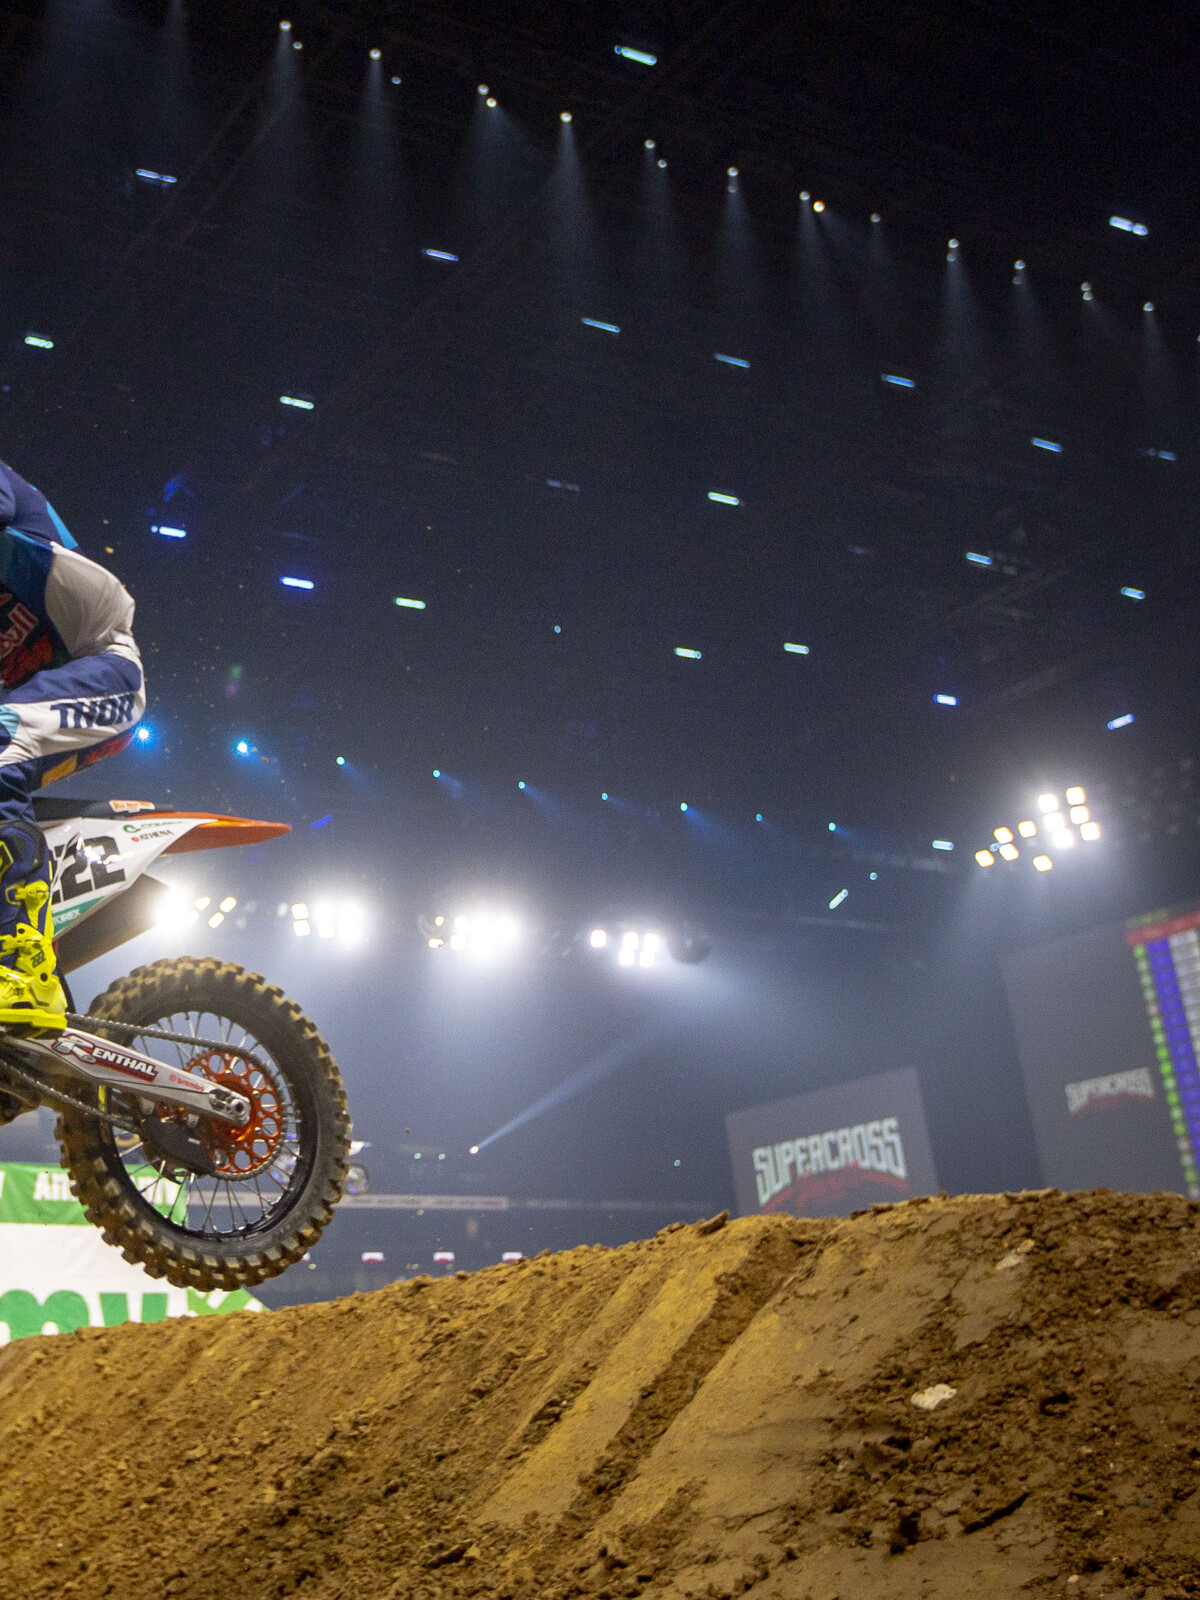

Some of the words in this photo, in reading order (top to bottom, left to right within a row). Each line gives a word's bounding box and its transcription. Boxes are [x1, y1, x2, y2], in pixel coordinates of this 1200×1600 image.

[50, 693, 134, 728] THOR
[139, 829, 174, 841] ATHENA
[50, 836, 127, 905] 22
[51, 1033, 157, 1077] RENTHAL
[752, 1117, 907, 1206] SUPERCROSS
